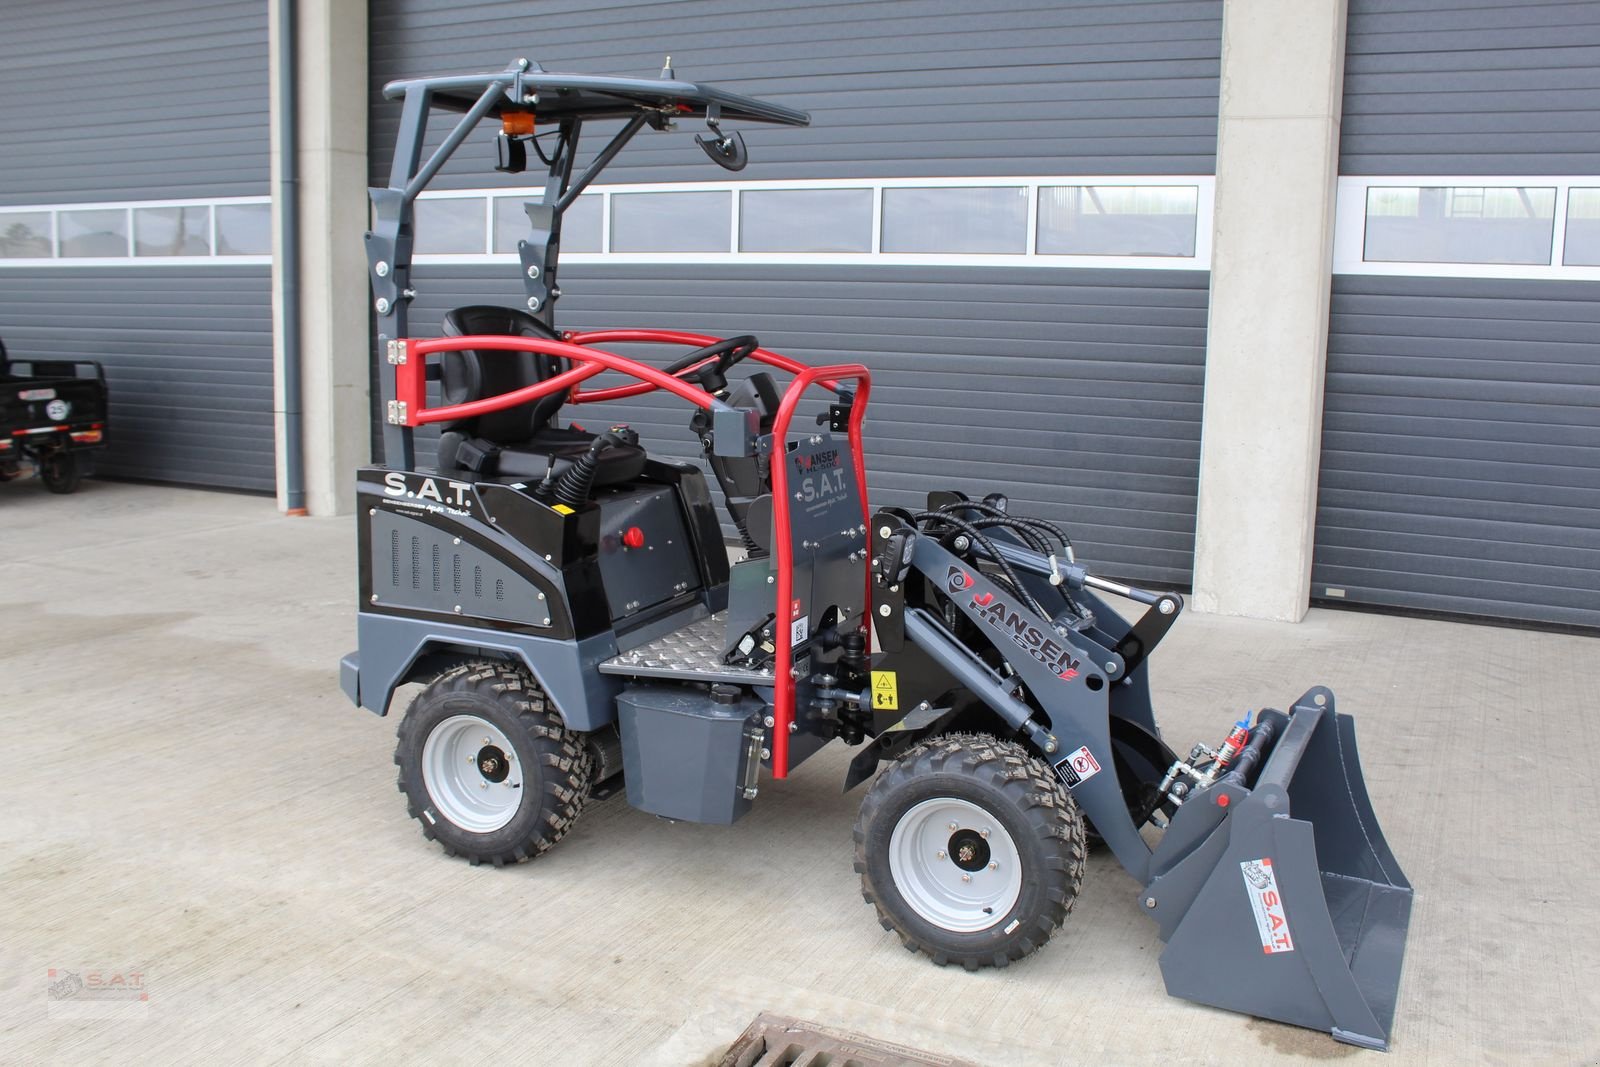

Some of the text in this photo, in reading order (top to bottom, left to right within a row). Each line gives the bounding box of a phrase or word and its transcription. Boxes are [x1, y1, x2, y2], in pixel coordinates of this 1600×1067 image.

[384, 472, 472, 507] S.A.T.
[802, 468, 846, 502] S.A.T.
[973, 592, 1081, 671] JANSEN
[1263, 890, 1291, 949] S.A.T.
